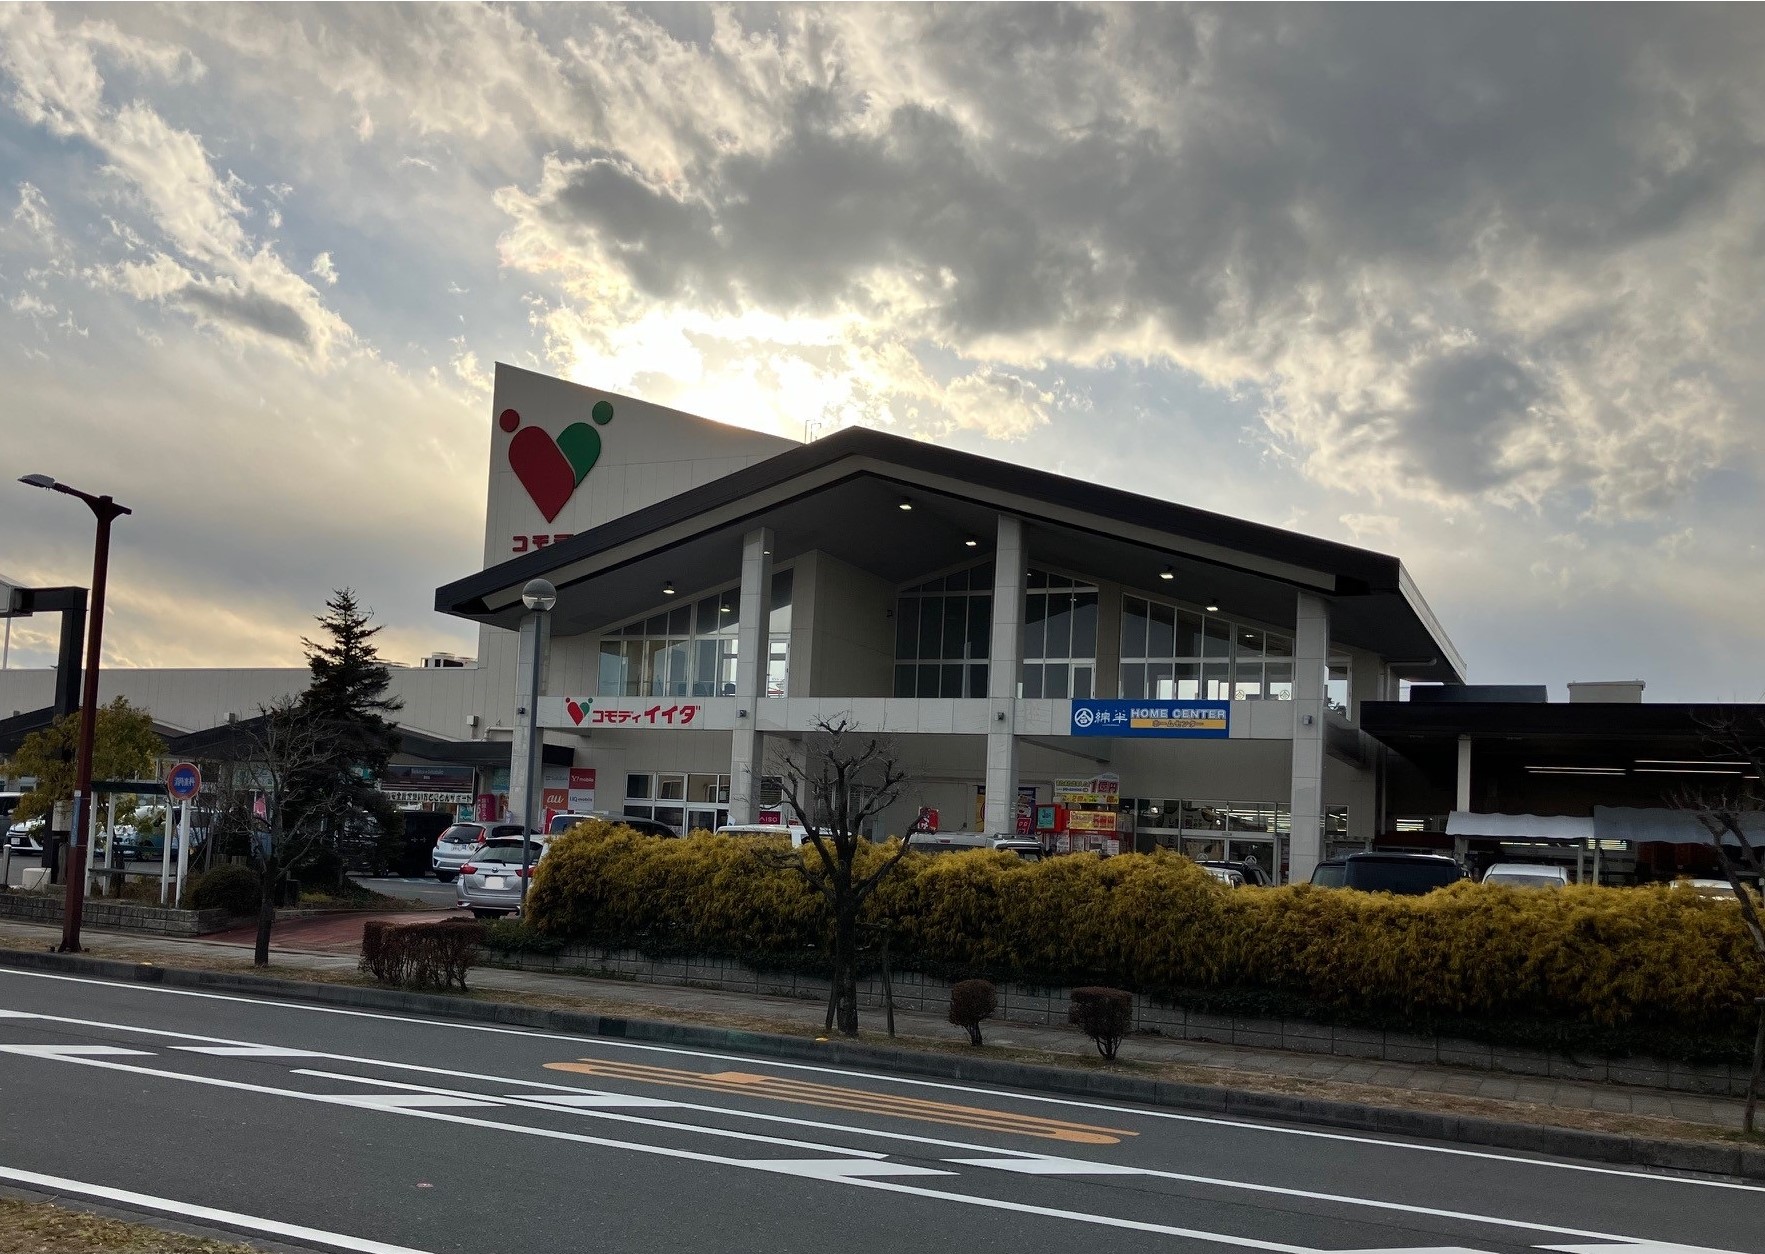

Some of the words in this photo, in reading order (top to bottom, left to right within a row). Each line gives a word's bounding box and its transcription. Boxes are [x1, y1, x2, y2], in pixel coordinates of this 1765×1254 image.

[592, 705, 701, 724] コモディイイダ
[1130, 708, 1169, 719] HOME
[1172, 708, 1227, 719] CENTER
[547, 795, 565, 804] au
